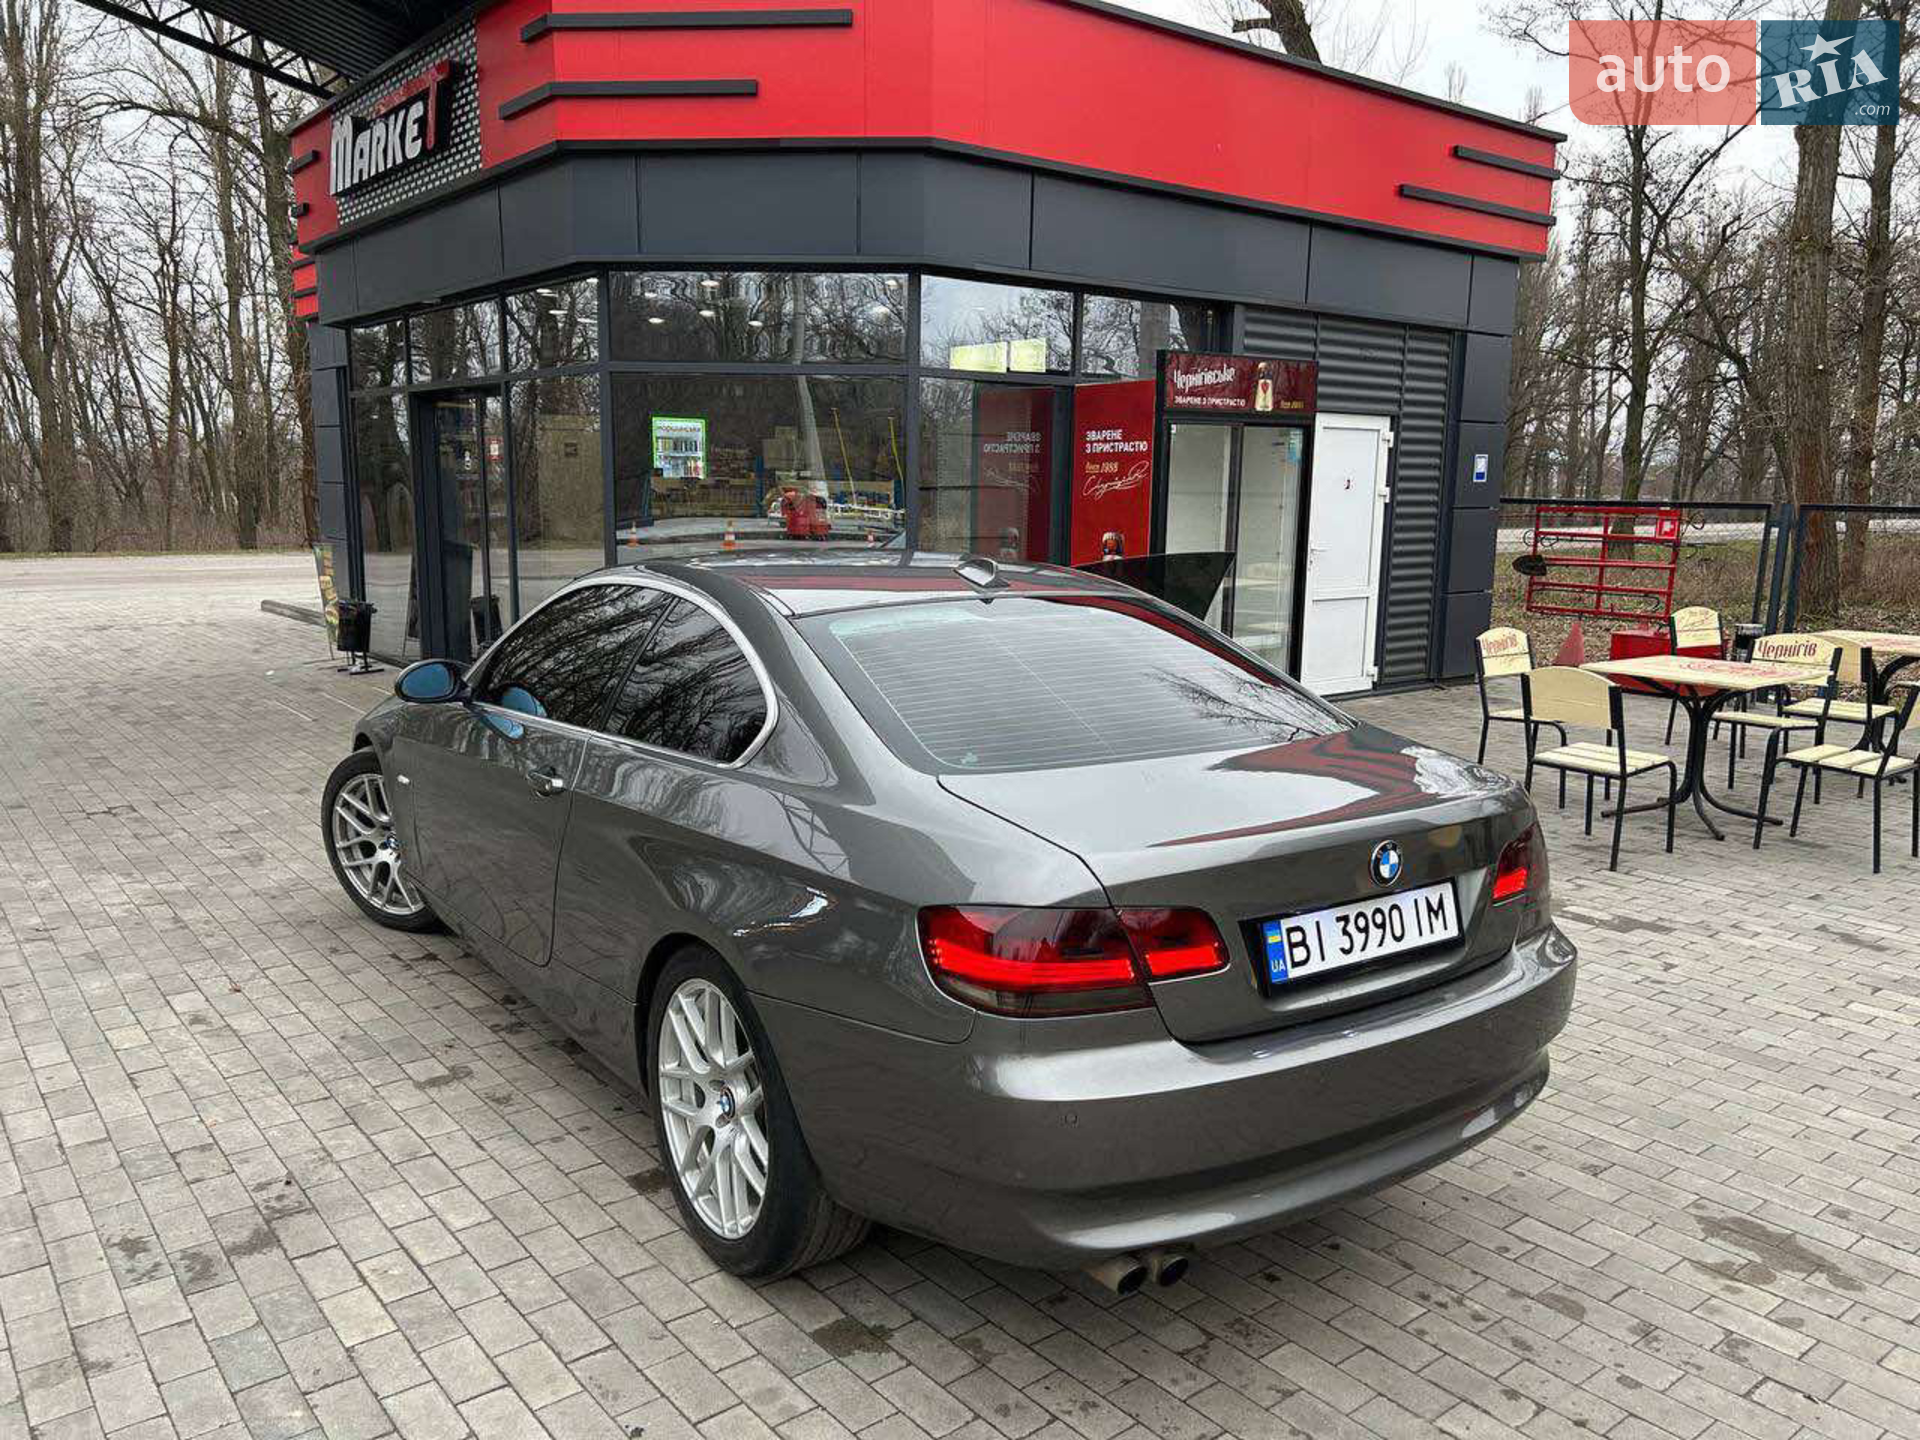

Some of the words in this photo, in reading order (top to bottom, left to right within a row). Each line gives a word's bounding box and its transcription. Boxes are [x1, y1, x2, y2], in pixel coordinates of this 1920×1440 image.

[1085, 428, 1123, 441] ЗВАРЕНЕ
[1085, 443, 1092, 454] З
[1092, 440, 1149, 454] ПРИСТРАСТЮ
[1286, 920, 1326, 969] BI
[1336, 903, 1404, 956] 3990
[1413, 893, 1449, 938] IM
[1270, 960, 1287, 974] UA
